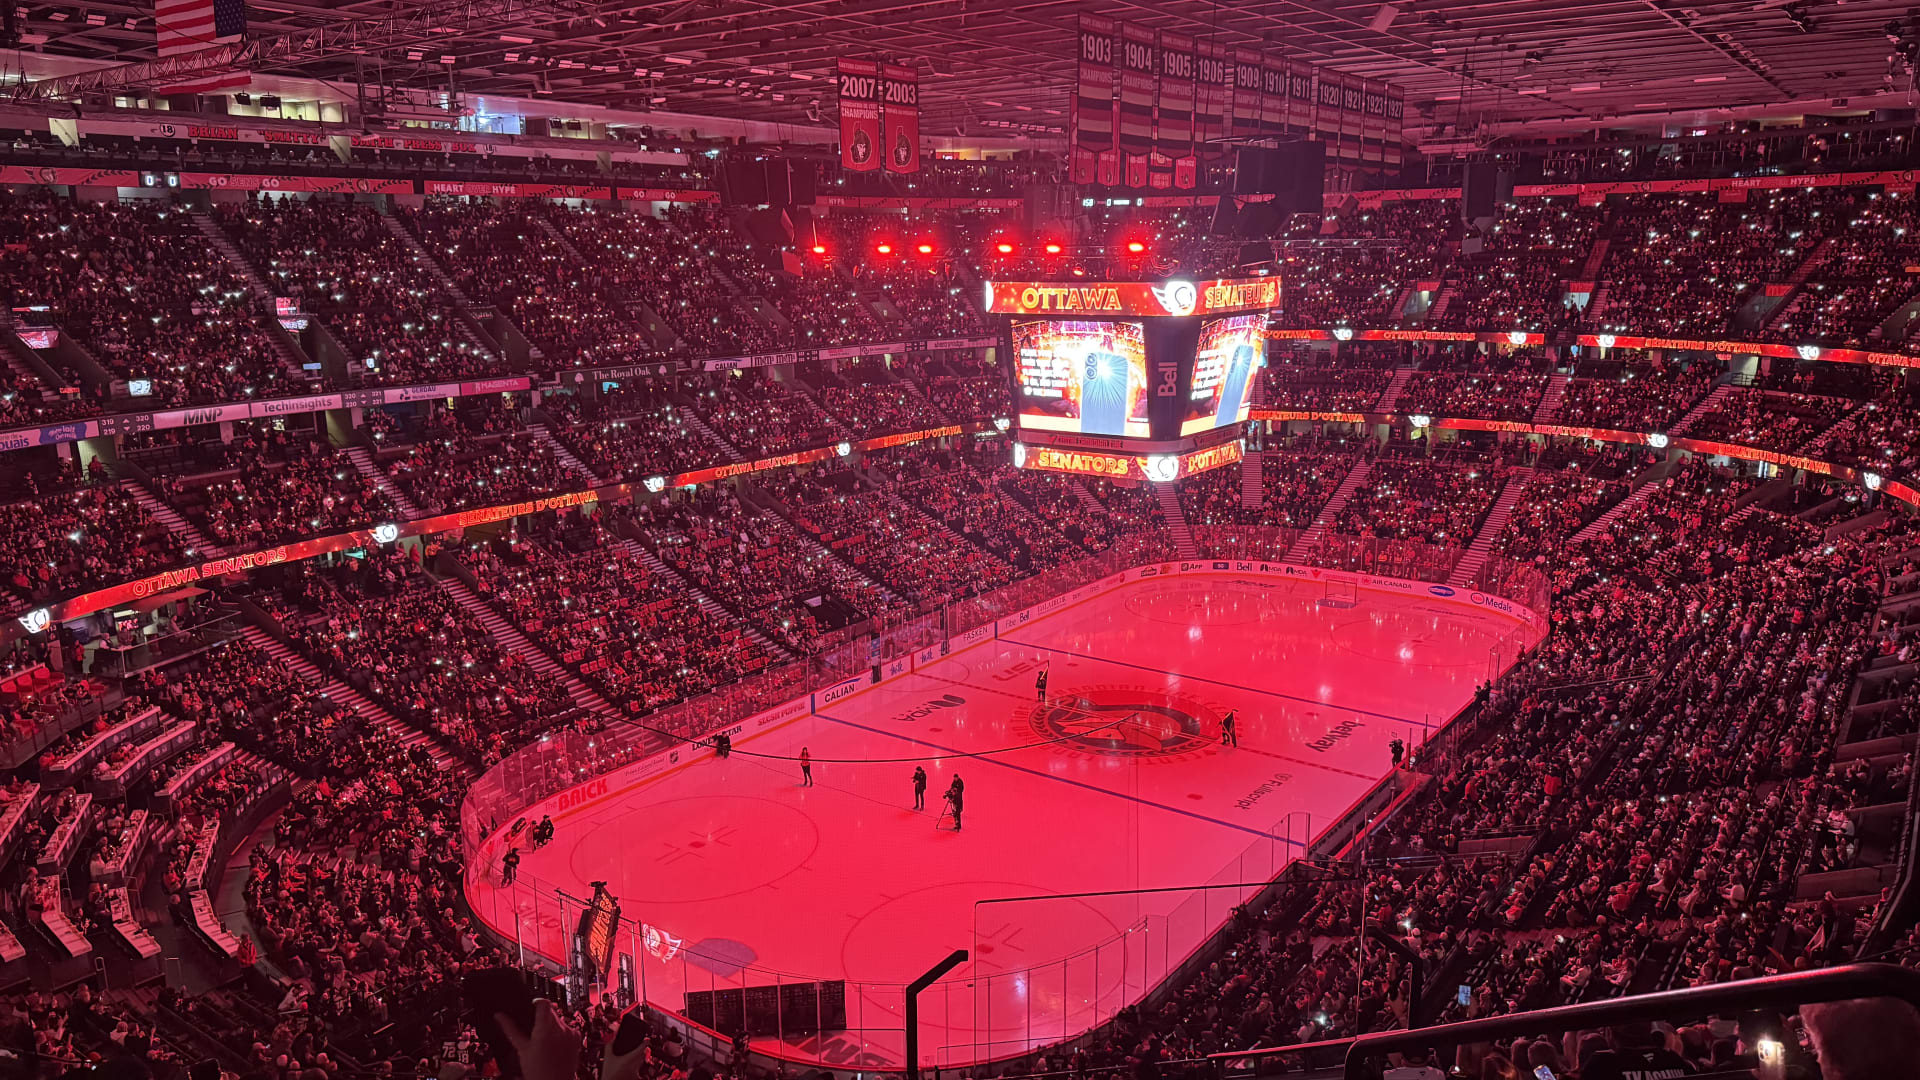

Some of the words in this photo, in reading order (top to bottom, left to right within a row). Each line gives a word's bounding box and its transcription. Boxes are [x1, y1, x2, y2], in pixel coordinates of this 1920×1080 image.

[1081, 33, 1112, 63] 1903
[1124, 42, 1153, 71] 1904
[1162, 51, 1192, 78] 1905
[1198, 58, 1224, 83] 1906
[841, 75, 875, 98] 2007
[1236, 65, 1260, 89] 1909
[1264, 71, 1285, 95] 1910
[1292, 76, 1311, 99] 1911
[886, 81, 916, 104] 2003
[1319, 83, 1340, 106] 1920
[1344, 88, 1362, 109] 1921
[841, 107, 880, 120] CHAMPIONS
[1366, 94, 1385, 114] 1923
[1387, 98, 1403, 118] 1927
[161, 125, 173, 134] 18
[188, 125, 238, 140] BRIAN
[403, 138, 442, 150] PRESS
[451, 142, 476, 152] BOX
[145, 175, 155, 187] 0
[167, 175, 178, 188] 0
[208, 176, 228, 187] GO
[262, 178, 280, 188] GO
[433, 183, 464, 194] HEART
[492, 185, 516, 195] HYPE
[633, 190, 644, 198] GO
[1021, 288, 1122, 311] OTTAWA
[1384, 330, 1424, 342] OTTAWA
[1424, 331, 1477, 343] SENATORS
[1707, 341, 1762, 354] D'OTTAWA
[1868, 353, 1909, 367] OTTAWA
[592, 370, 609, 381] The
[610, 368, 633, 380] Royal
[634, 366, 651, 376] Oak
[1158, 361, 1179, 399] Bell
[183, 407, 223, 424] MNP
[1486, 421, 1532, 433] OTTAWA
[1039, 450, 1129, 475] SENATORS
[1188, 439, 1237, 472] D'OTTAWA
[1780, 453, 1832, 475] D'OTTAWA
[715, 461, 753, 479] OTTAWA
[536, 490, 599, 512] D'OTTAWA
[133, 567, 201, 597] OTTAWA
[202, 546, 288, 578] SENATORS
[1236, 562, 1252, 572] Bell
[1372, 578, 1383, 586] AIR
[1383, 580, 1412, 590] CANADA
[1485, 596, 1513, 613] Medals
[1020, 611, 1030, 623] Bell
[964, 626, 988, 641] FASKEN
[824, 683, 856, 704] CALIAN
[1305, 719, 1366, 753] betway
[558, 778, 609, 811] BRICK
[442, 1046, 456, 1059] 72
